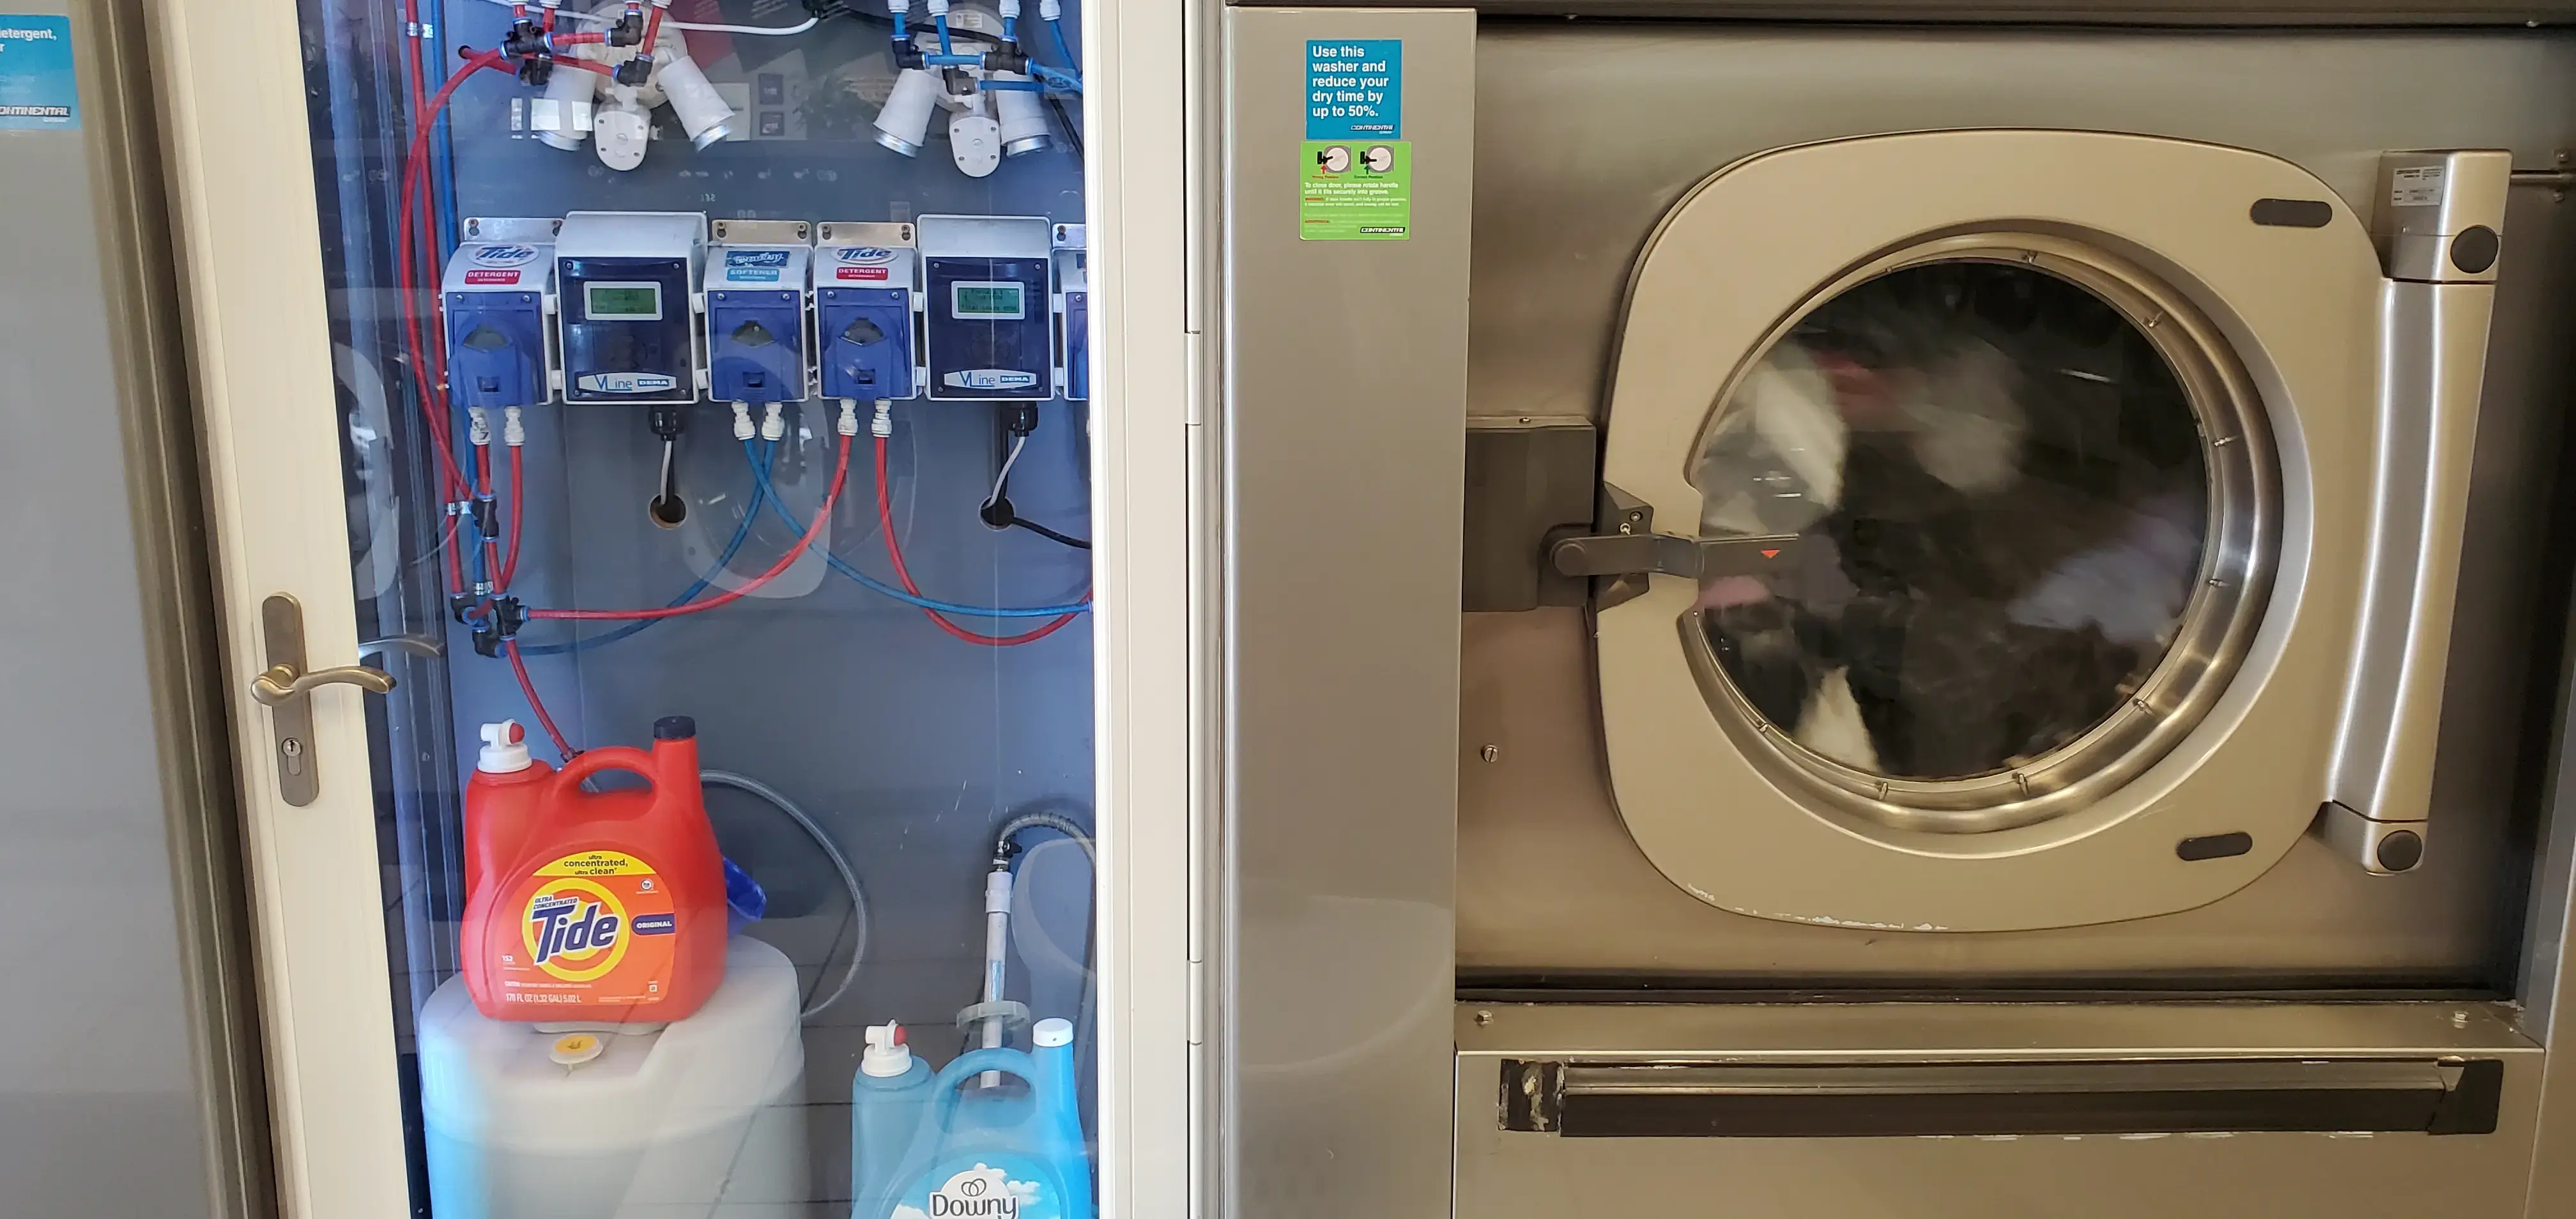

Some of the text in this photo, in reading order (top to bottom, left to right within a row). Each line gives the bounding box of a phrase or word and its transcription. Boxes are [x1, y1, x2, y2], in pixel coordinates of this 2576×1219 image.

[0, 28, 57, 41] etergent,
[1313, 45, 1365, 57] Use this
[1312, 60, 1386, 72] washer and
[1312, 75, 1389, 89] reduce your
[1312, 90, 1383, 105] dry time by
[1313, 105, 1379, 119] up to 50%.
[477, 247, 534, 259] Tide
[838, 247, 892, 259] Tide
[564, 859, 628, 868] concentrated,
[533, 898, 578, 910] CONCENTRATED
[636, 921, 673, 929] ORIGINAL
[532, 904, 618, 963] Tide
[932, 1194, 1017, 1219] Downy
